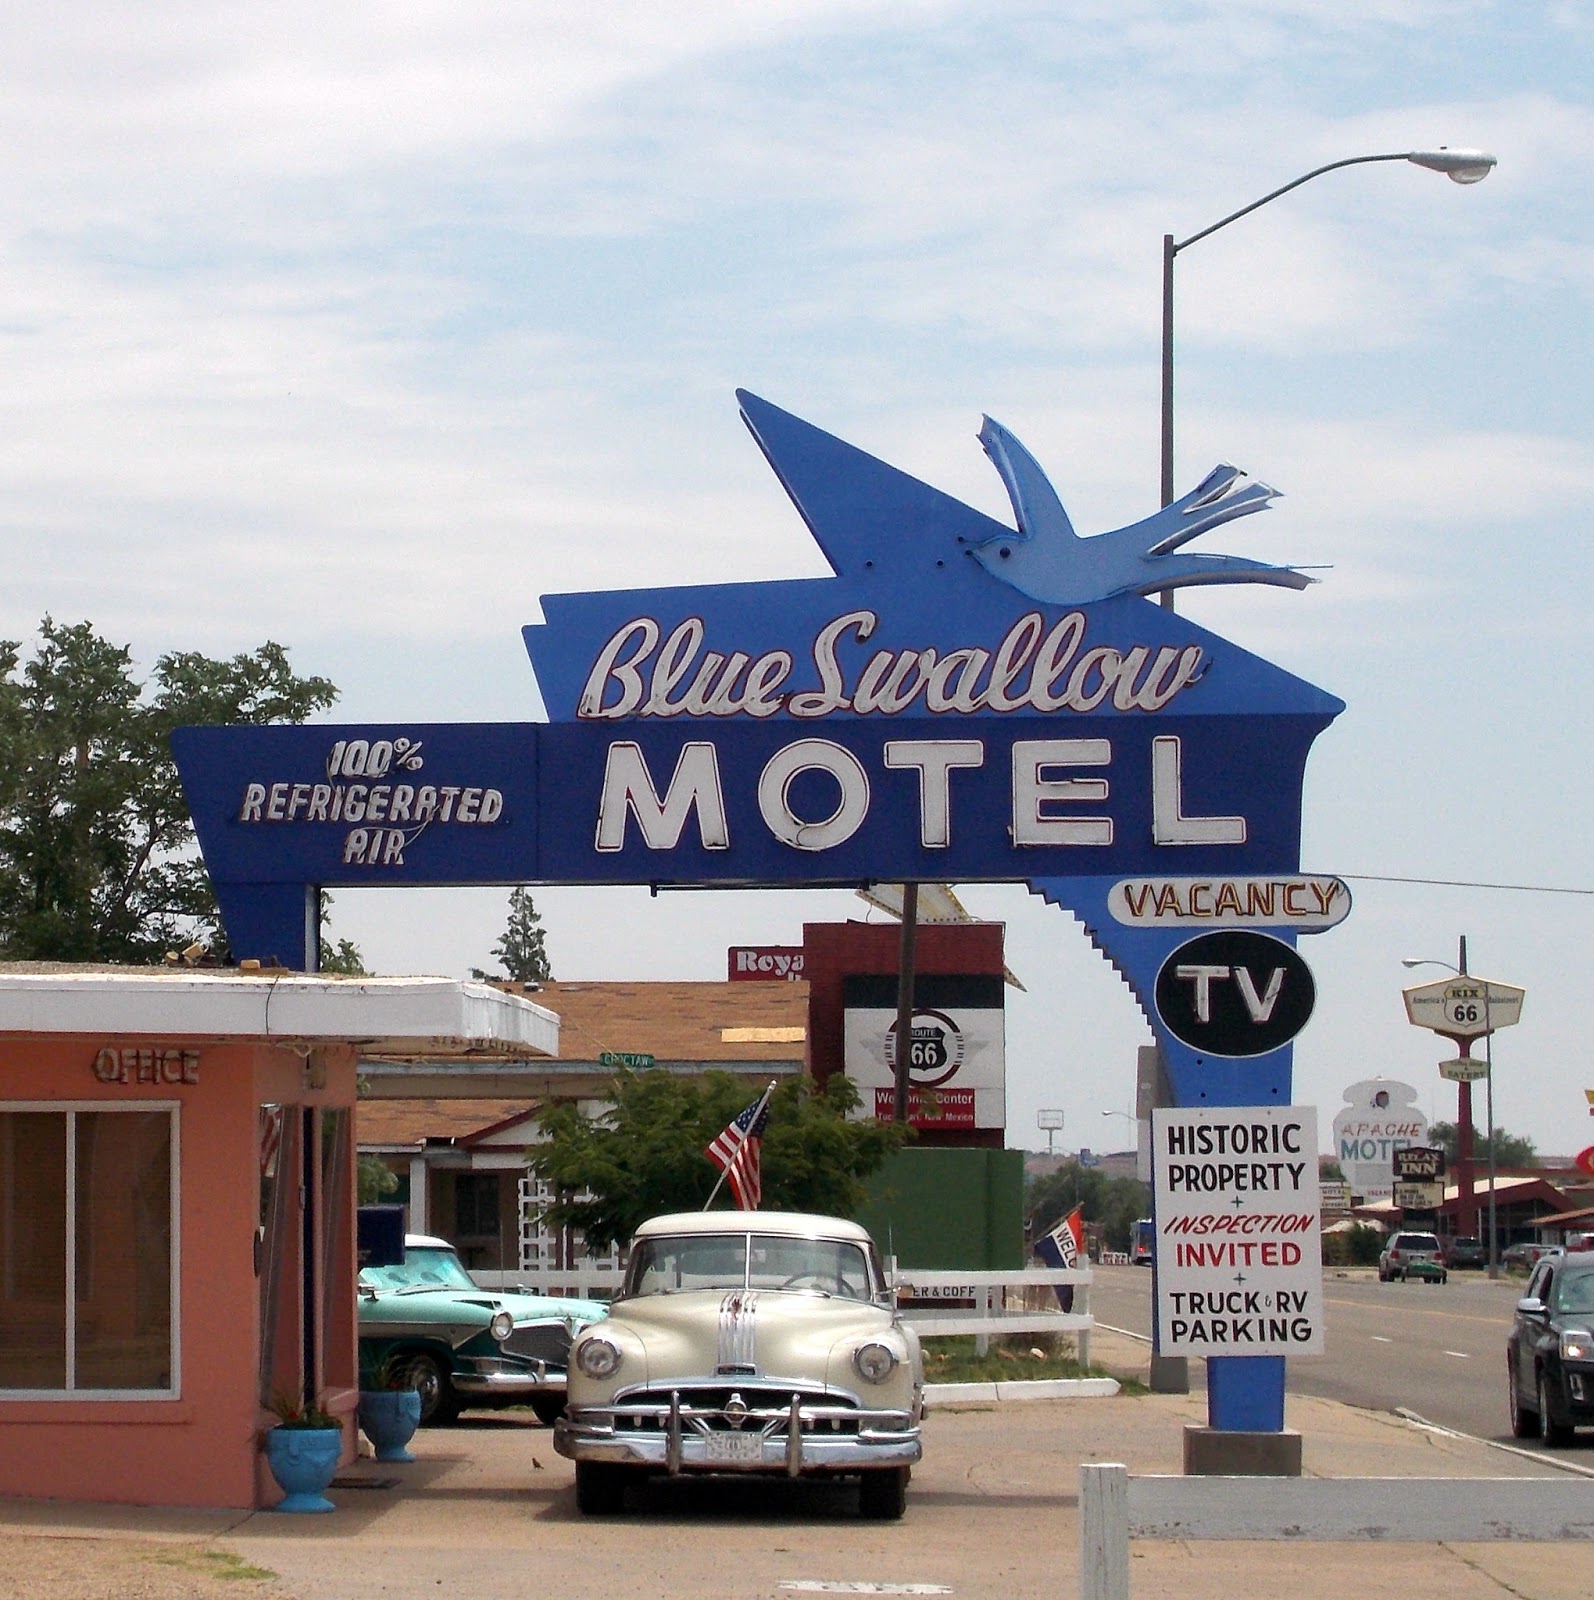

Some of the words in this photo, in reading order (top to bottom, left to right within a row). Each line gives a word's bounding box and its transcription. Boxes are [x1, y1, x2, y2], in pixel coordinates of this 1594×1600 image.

[577, 617, 792, 720] Blue
[785, 611, 1207, 717] Swallow
[328, 737, 424, 778] 100%
[239, 782, 504, 823] REFRIGERATED
[593, 735, 1248, 853] MOTEL
[342, 829, 406, 865] AIR
[1123, 880, 1340, 917] VACANCY
[1175, 964, 1288, 1024] TV
[1452, 989, 1479, 998] KIX
[1453, 1004, 1478, 1022] 66
[93, 1047, 200, 1085] OFFICE
[910, 1042, 938, 1065] 66
[935, 1092, 974, 1104] Center
[945, 1112, 974, 1121] Mexico
[1167, 1123, 1302, 1155] HISTORIC
[1341, 1123, 1422, 1136] APACHE
[1167, 1162, 1307, 1192] PROPERTY
[1400, 1162, 1438, 1174] INN
[1162, 1213, 1316, 1235] INSPECTION
[1176, 1242, 1302, 1267] INVITED
[932, 1286, 940, 1297] &
[1169, 1290, 1261, 1315] TRUCK
[1275, 1290, 1309, 1314] RV
[1170, 1317, 1313, 1343] PARKING
